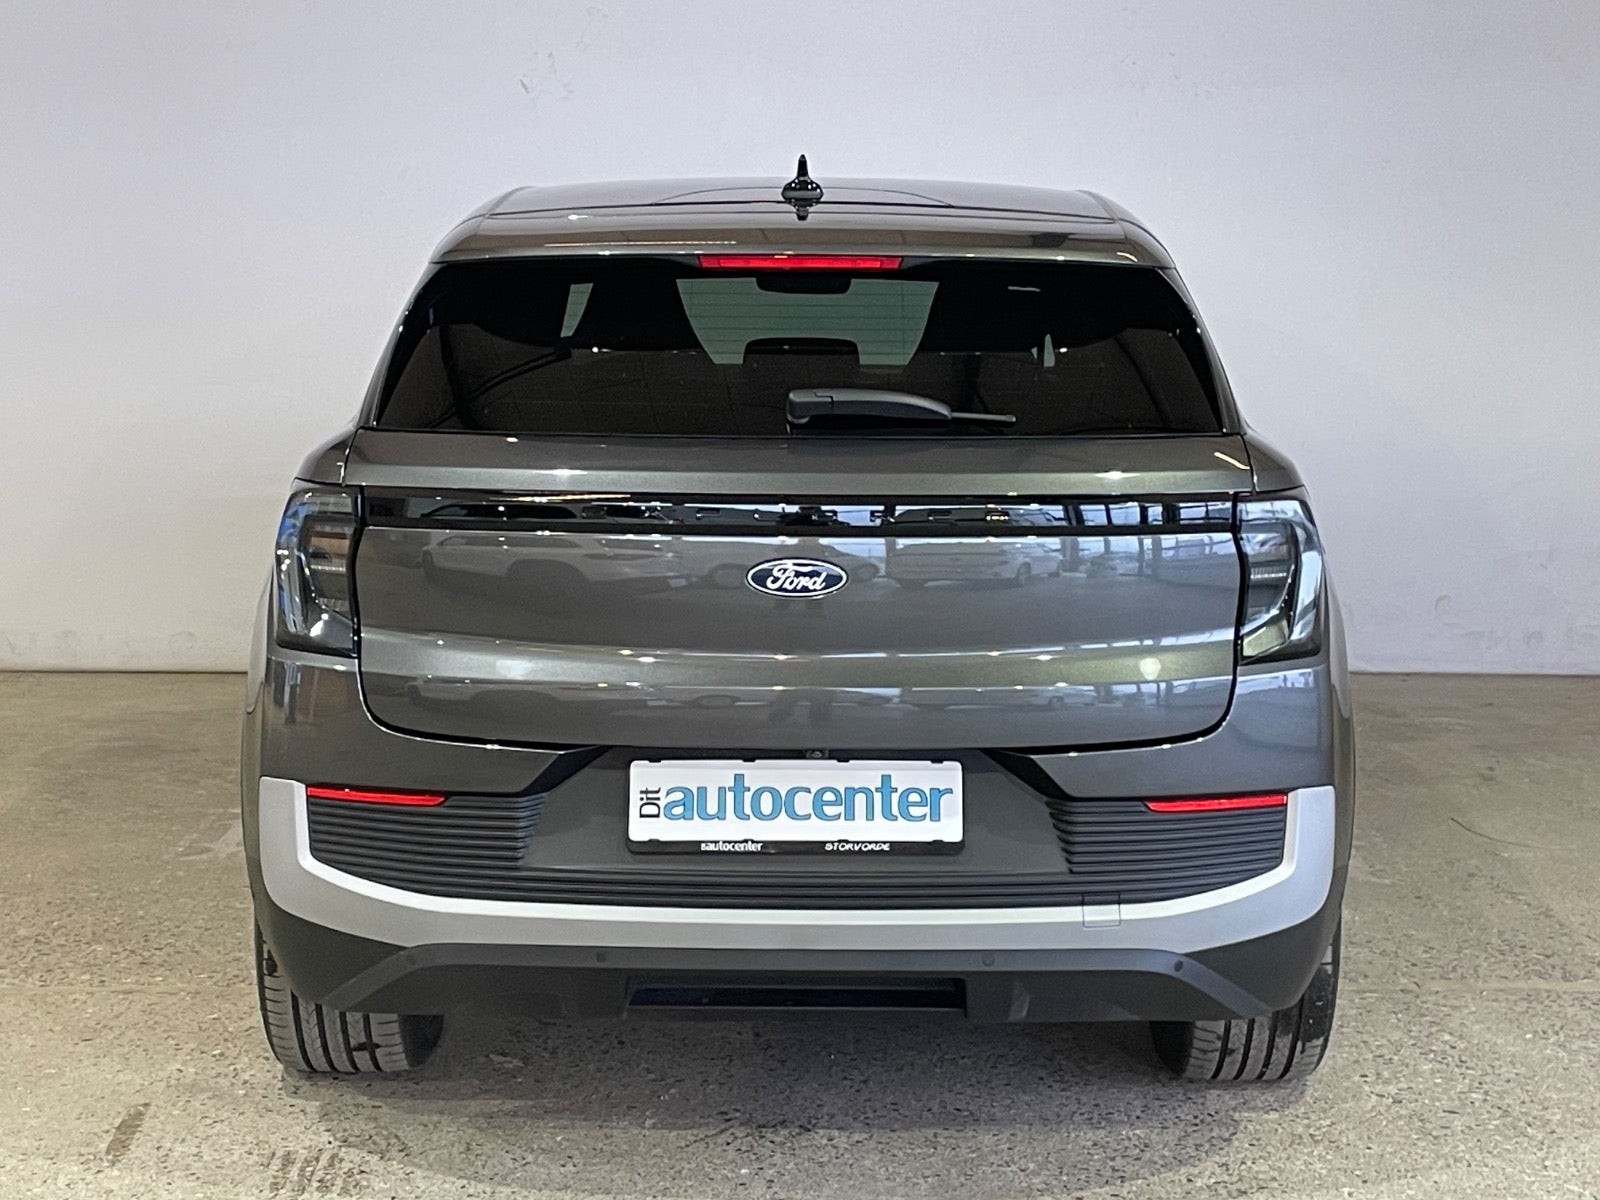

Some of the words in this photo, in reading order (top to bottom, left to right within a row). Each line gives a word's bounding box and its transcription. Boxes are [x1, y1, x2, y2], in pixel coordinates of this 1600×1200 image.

[766, 562, 827, 590] Ford
[639, 787, 661, 818] Dit
[663, 773, 953, 822] autocenter
